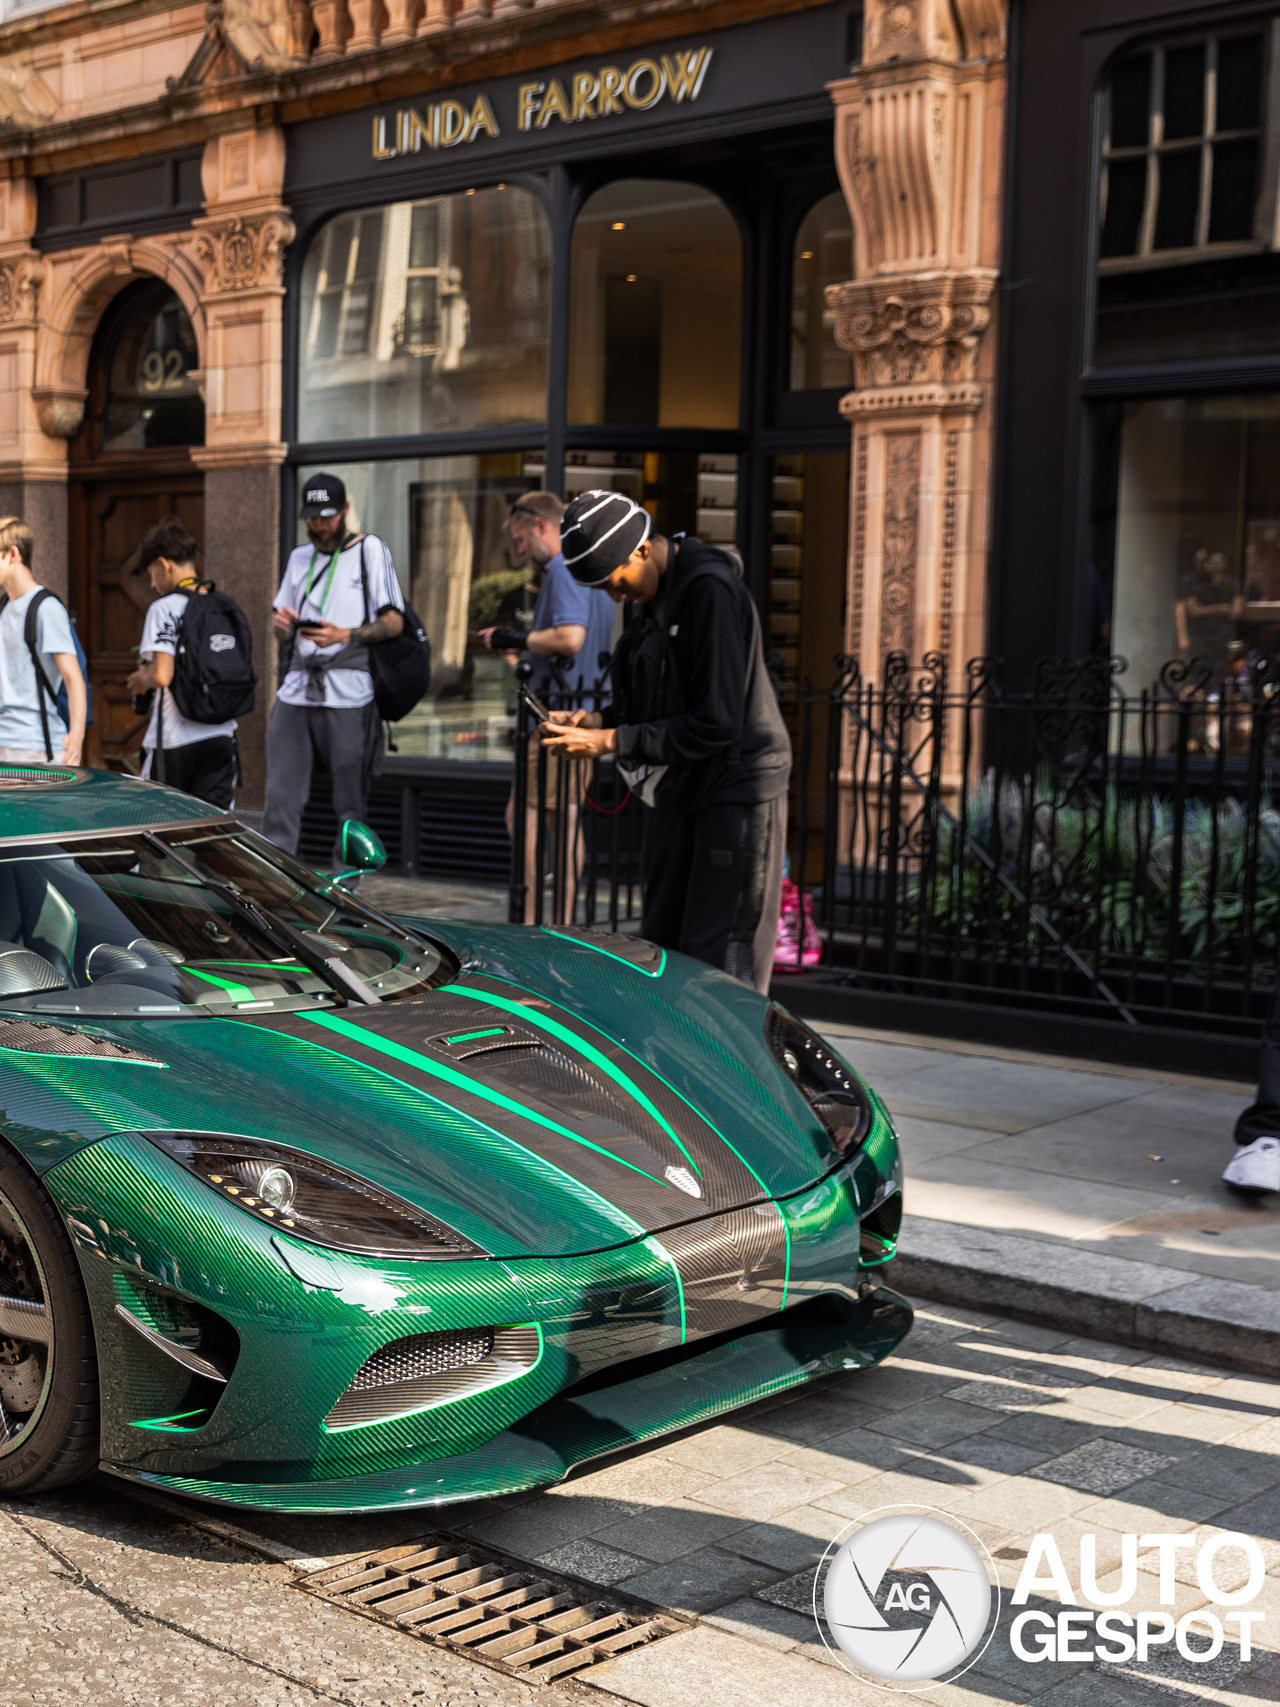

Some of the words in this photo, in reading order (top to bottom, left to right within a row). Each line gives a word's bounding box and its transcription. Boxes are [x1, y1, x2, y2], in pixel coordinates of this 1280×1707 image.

[372, 96, 499, 160] LINDA
[518, 46, 714, 132] FARROW
[143, 350, 183, 392] 92
